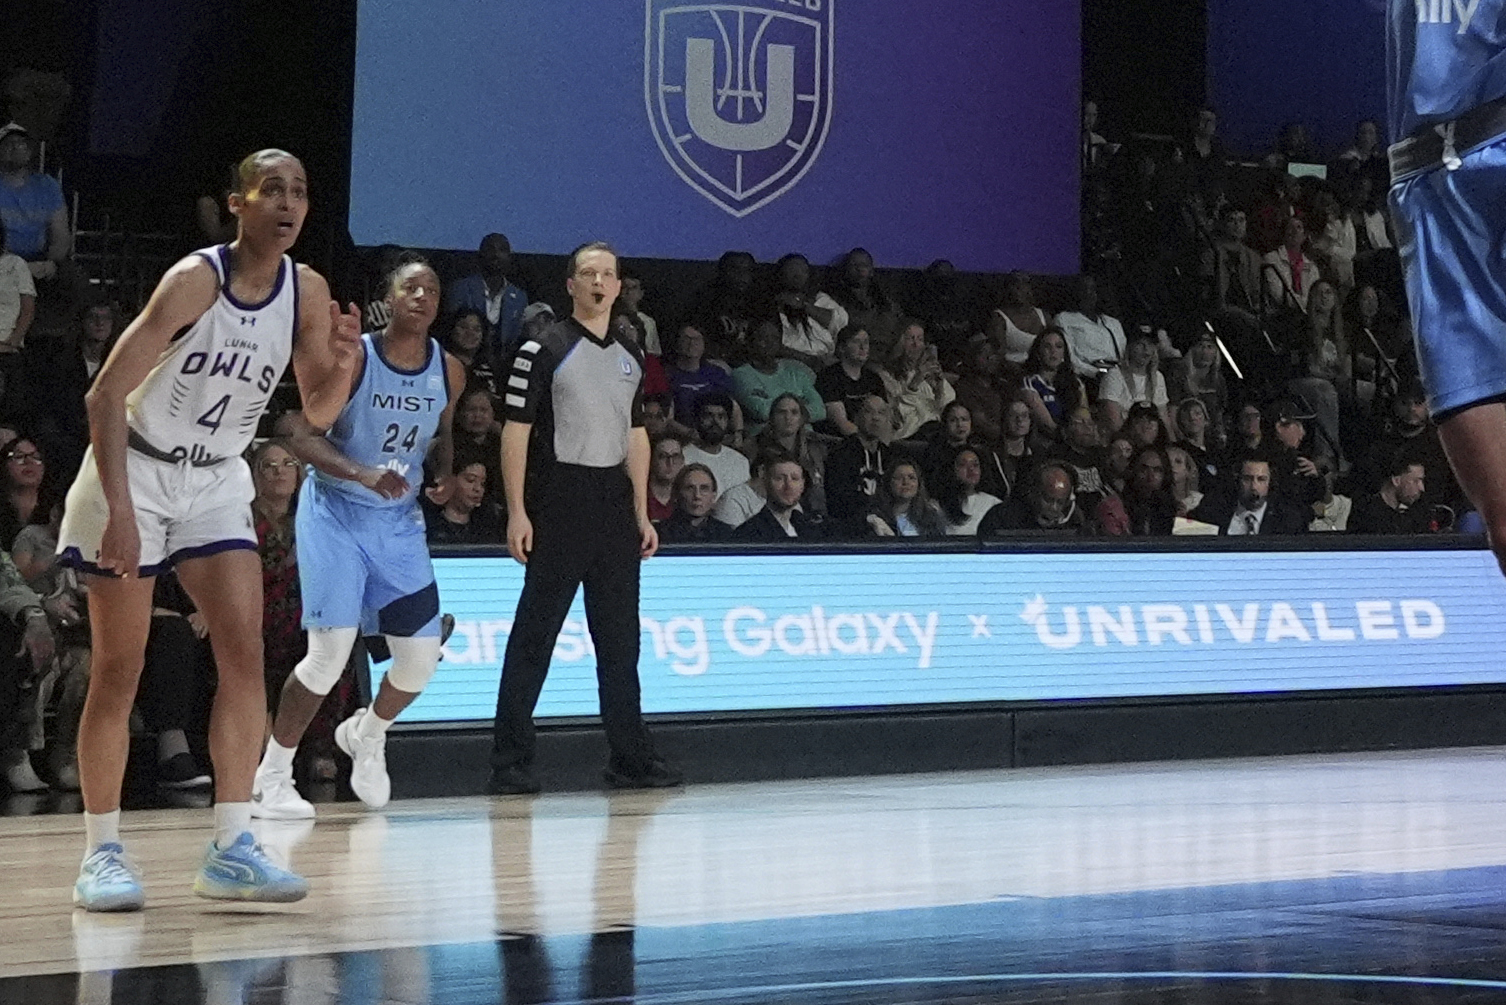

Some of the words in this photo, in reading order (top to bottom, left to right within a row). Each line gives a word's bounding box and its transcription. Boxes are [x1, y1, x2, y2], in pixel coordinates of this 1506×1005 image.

[180, 351, 276, 395] OWLS
[196, 394, 232, 435] 4
[372, 393, 437, 412] MIST
[381, 422, 420, 453] 24
[723, 604, 938, 669] Galaxy
[1035, 598, 1447, 649] UNRIVALED
